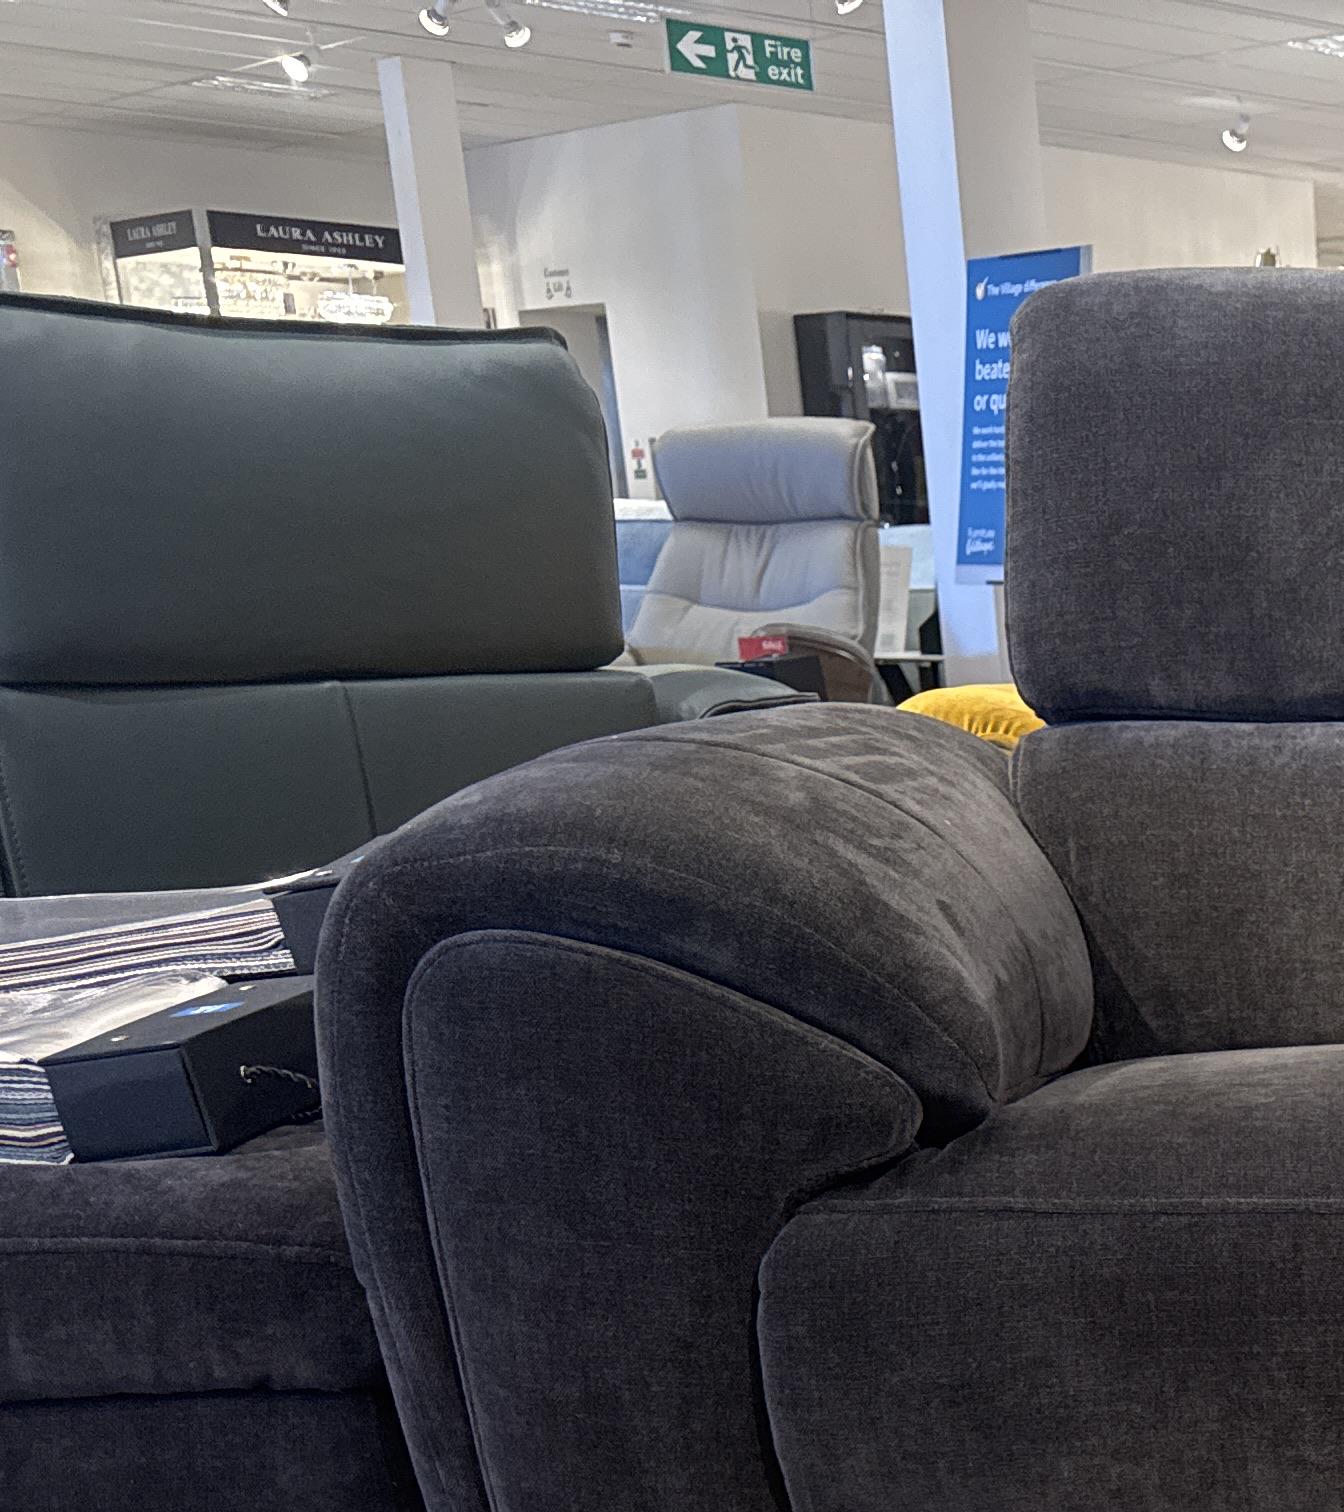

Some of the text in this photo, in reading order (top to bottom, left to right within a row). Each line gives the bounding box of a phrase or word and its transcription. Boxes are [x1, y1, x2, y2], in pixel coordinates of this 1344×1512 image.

[763, 39, 802, 62] Fire
[767, 64, 805, 84] exit
[256, 223, 385, 249] LAURA ASHLEY
[975, 329, 996, 350] We
[973, 394, 989, 411] or
